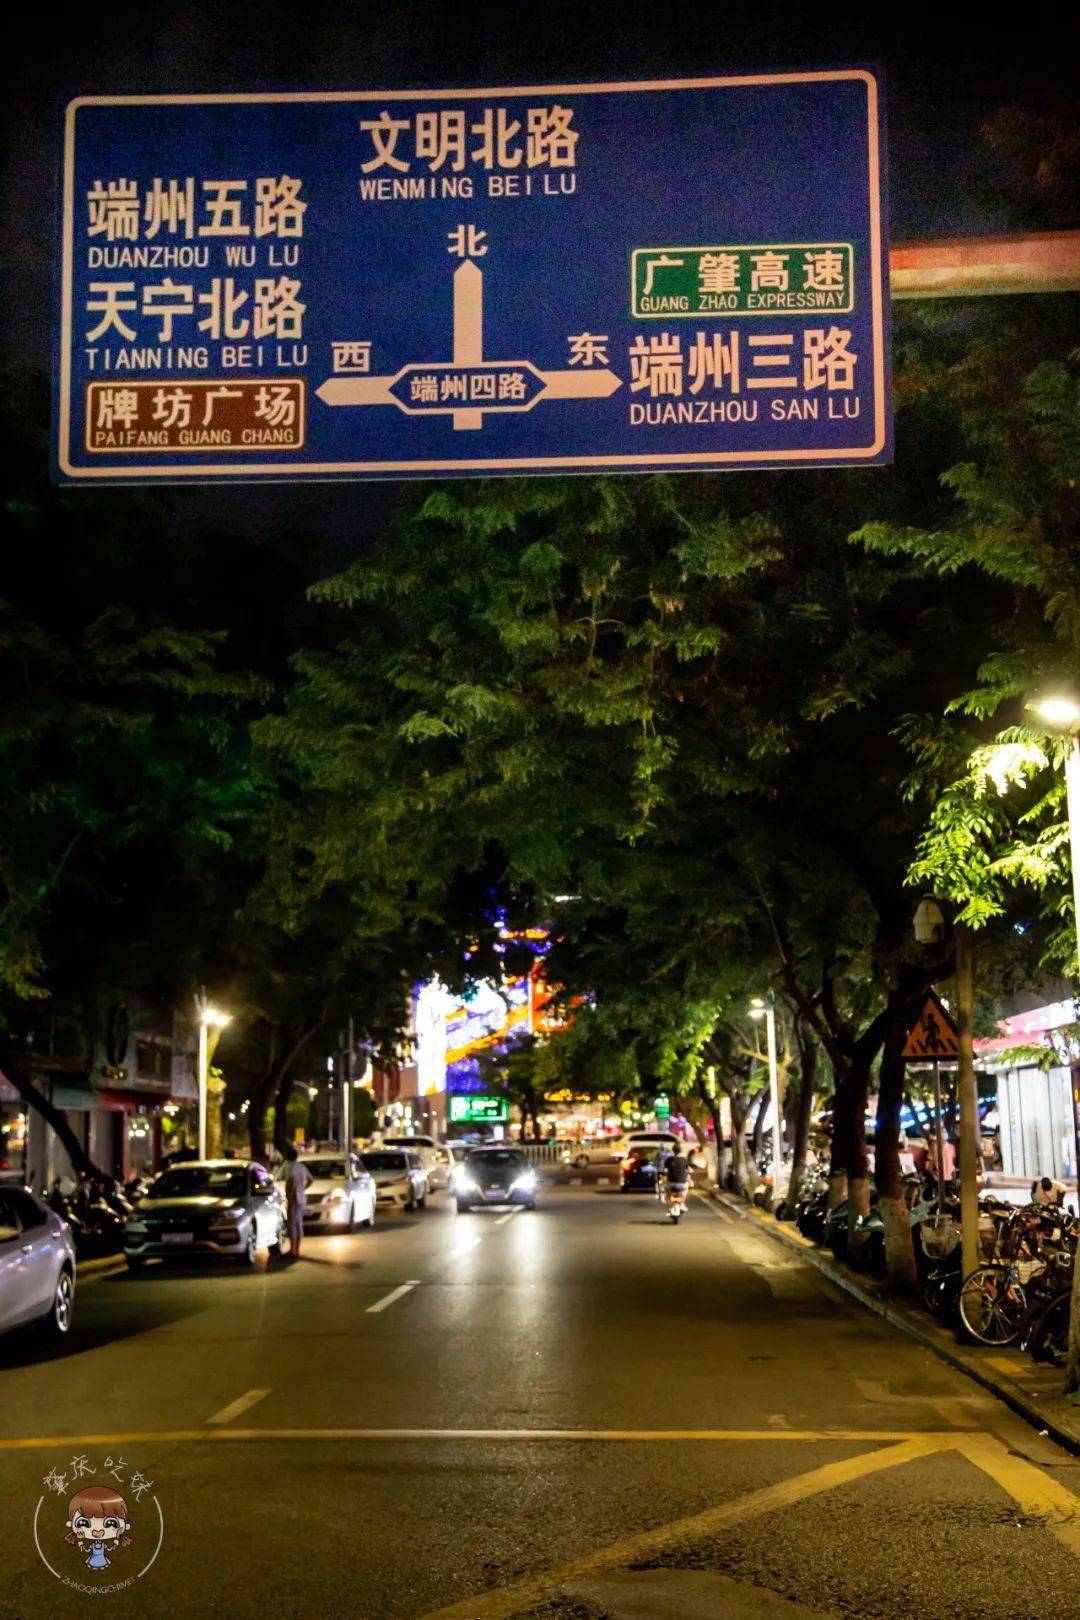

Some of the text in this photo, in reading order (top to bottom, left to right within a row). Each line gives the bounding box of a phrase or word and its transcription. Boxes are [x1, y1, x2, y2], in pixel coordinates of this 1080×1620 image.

[359, 105, 580, 174] 文明北路
[359, 173, 576, 200] WENMING BEI LU
[86, 175, 308, 242] 端州五路
[88, 245, 299, 269] DUANZHOU WU LU
[447, 224, 488, 259] 北
[641, 249, 845, 296] 广肇高速
[85, 276, 307, 343] 天宁北路
[640, 292, 844, 311] GUANG ZHAO EXPRESSWAY
[85, 345, 309, 371] TIANNING BEI LU
[331, 341, 372, 373] 西
[567, 332, 611, 366] 东
[629, 325, 859, 398] 端州三路
[410, 371, 527, 403] 端州四路
[96, 385, 296, 430] 牌坊广场
[630, 397, 861, 426] DUANZHOU SAN LU
[95, 428, 295, 446] PAIFANG GUANG CHANG
